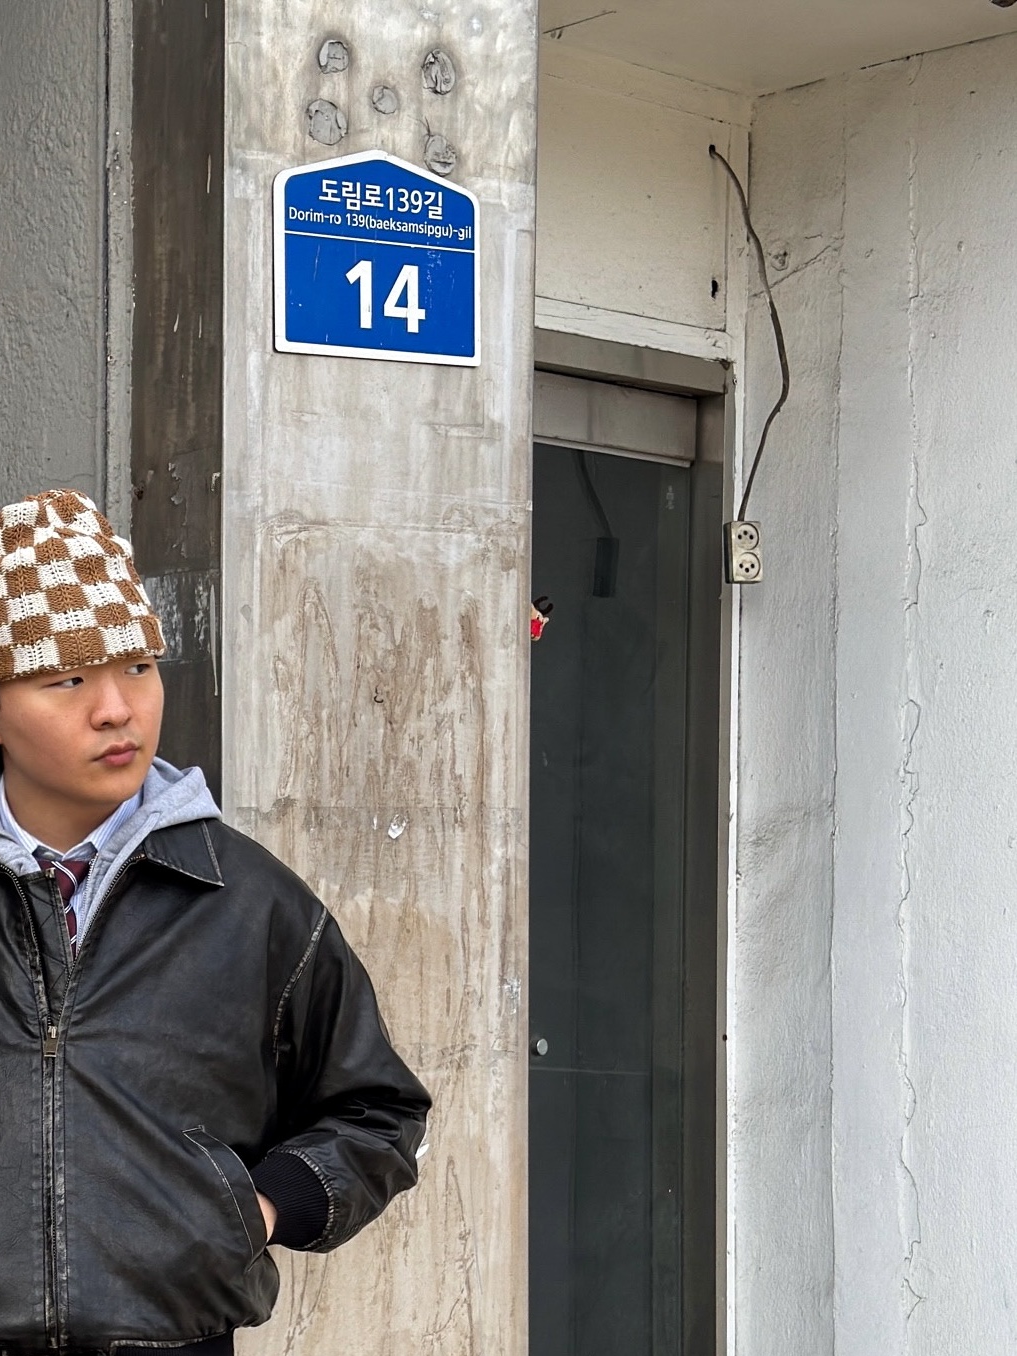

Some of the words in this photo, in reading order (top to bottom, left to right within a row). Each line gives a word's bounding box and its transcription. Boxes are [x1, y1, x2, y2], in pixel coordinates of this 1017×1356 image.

[319, 178, 444, 220] 도림로139길
[288, 206, 342, 225] Dorim-ro
[345, 213, 472, 240] 139(baeksamsipgu)-gil
[345, 259, 426, 333] 14
